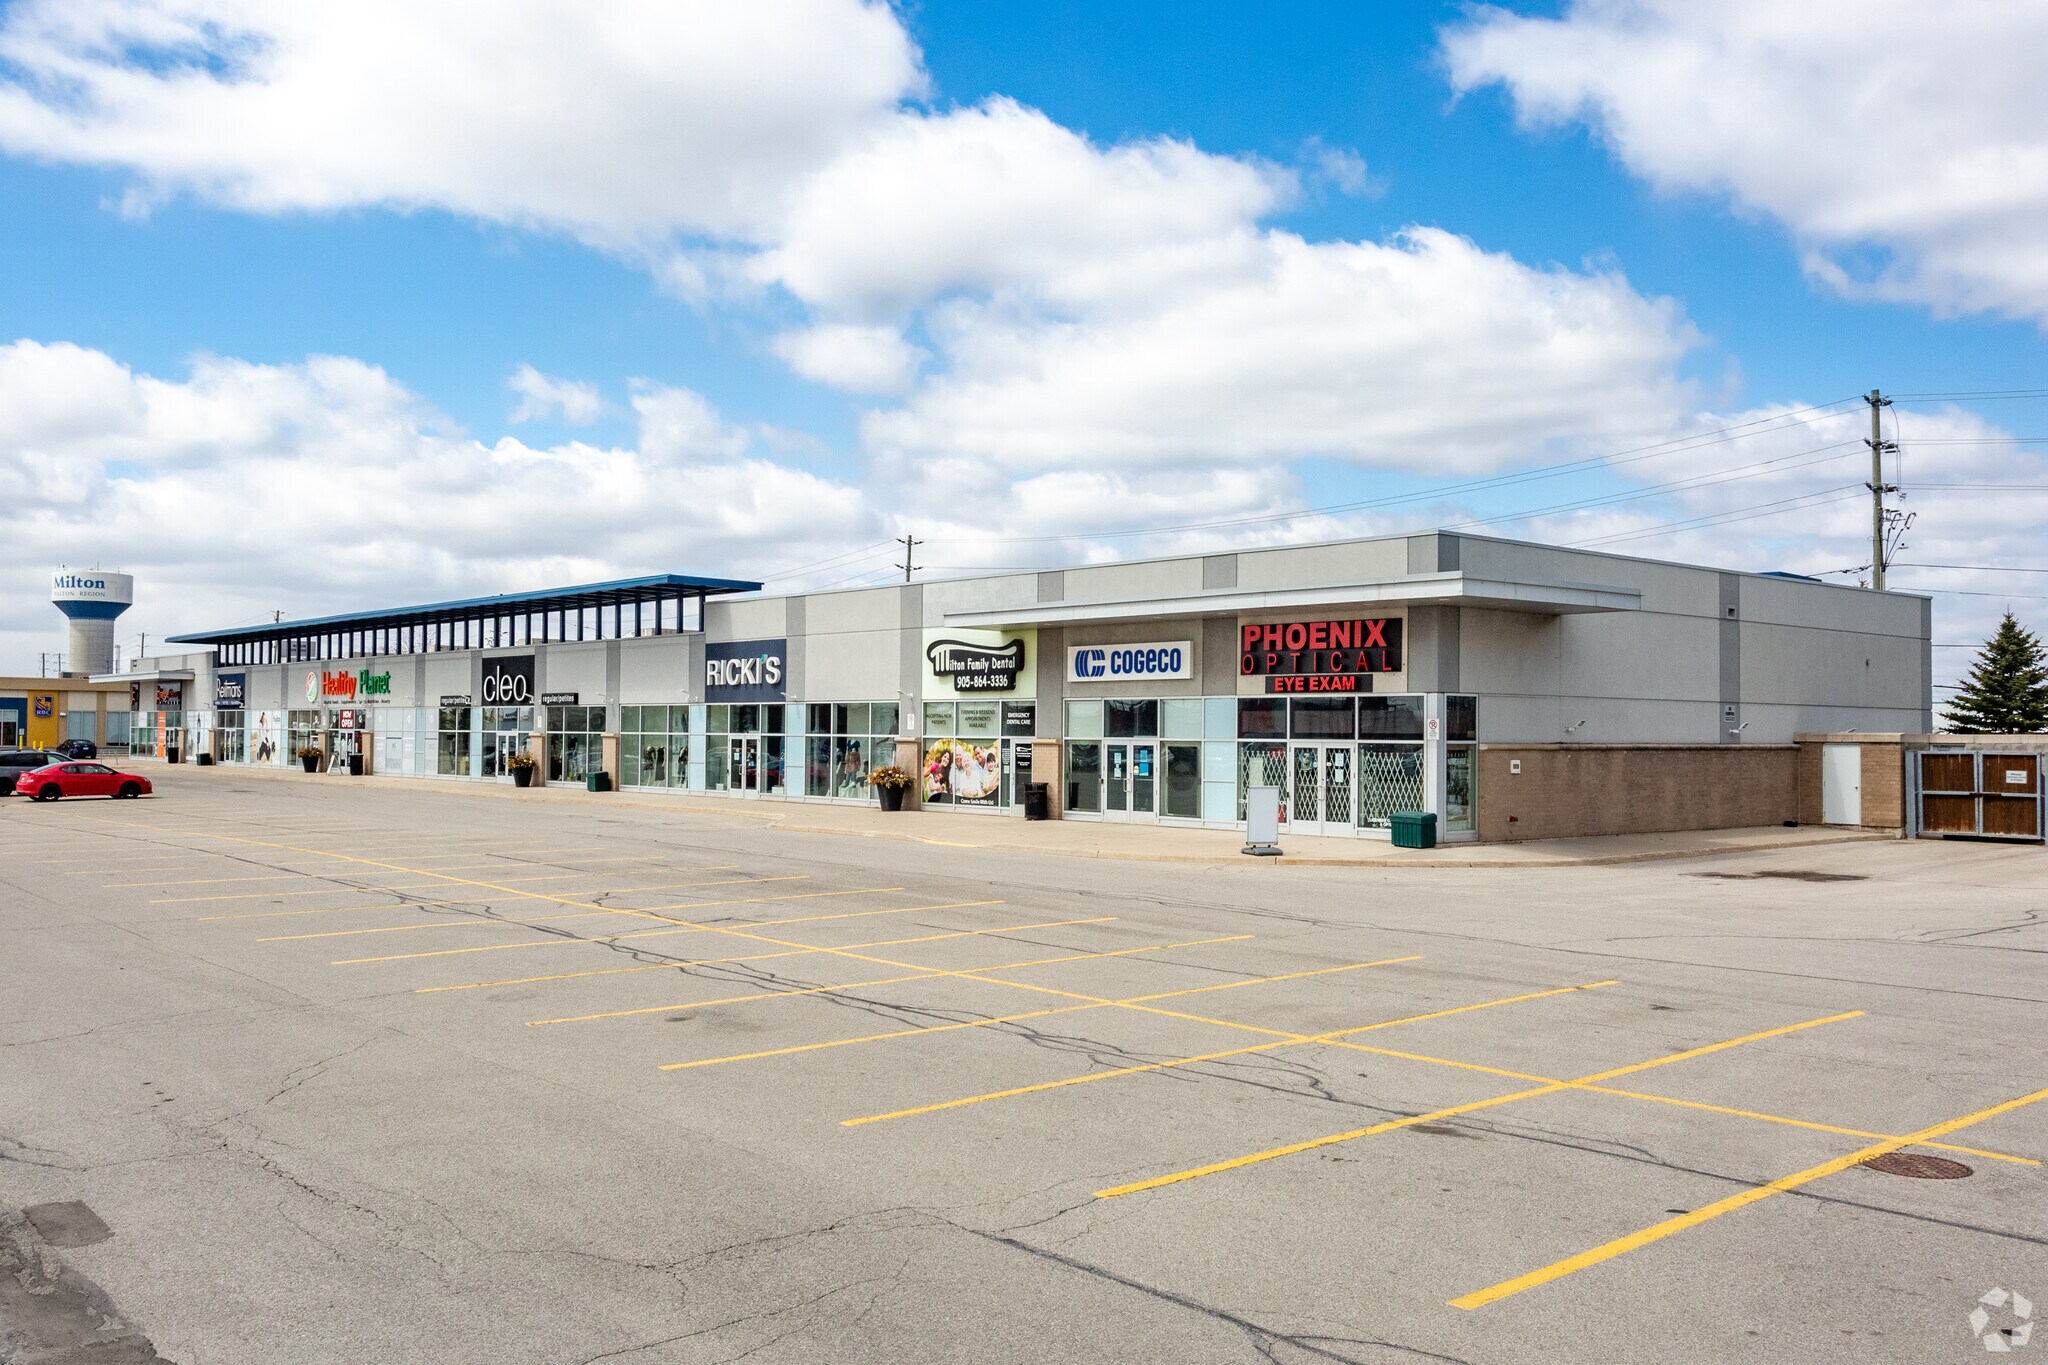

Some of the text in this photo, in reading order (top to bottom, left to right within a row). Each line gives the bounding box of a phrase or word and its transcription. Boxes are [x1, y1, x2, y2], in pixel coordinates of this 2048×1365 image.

[54, 575, 106, 589] Milton
[1243, 619, 1387, 651] PHOENIX
[706, 654, 781, 685] RICKI'S
[967, 657, 990, 673] Family
[991, 656, 1016, 670] Dental
[1241, 650, 1392, 674] OPTICAL
[322, 669, 391, 700] Healthy Planet
[483, 665, 527, 702] cleo
[957, 674, 1008, 689] 905-864-3336
[1274, 676, 1355, 692] EYE EXAM
[342, 710, 353, 718] NOW
[341, 719, 353, 728] OPEN
